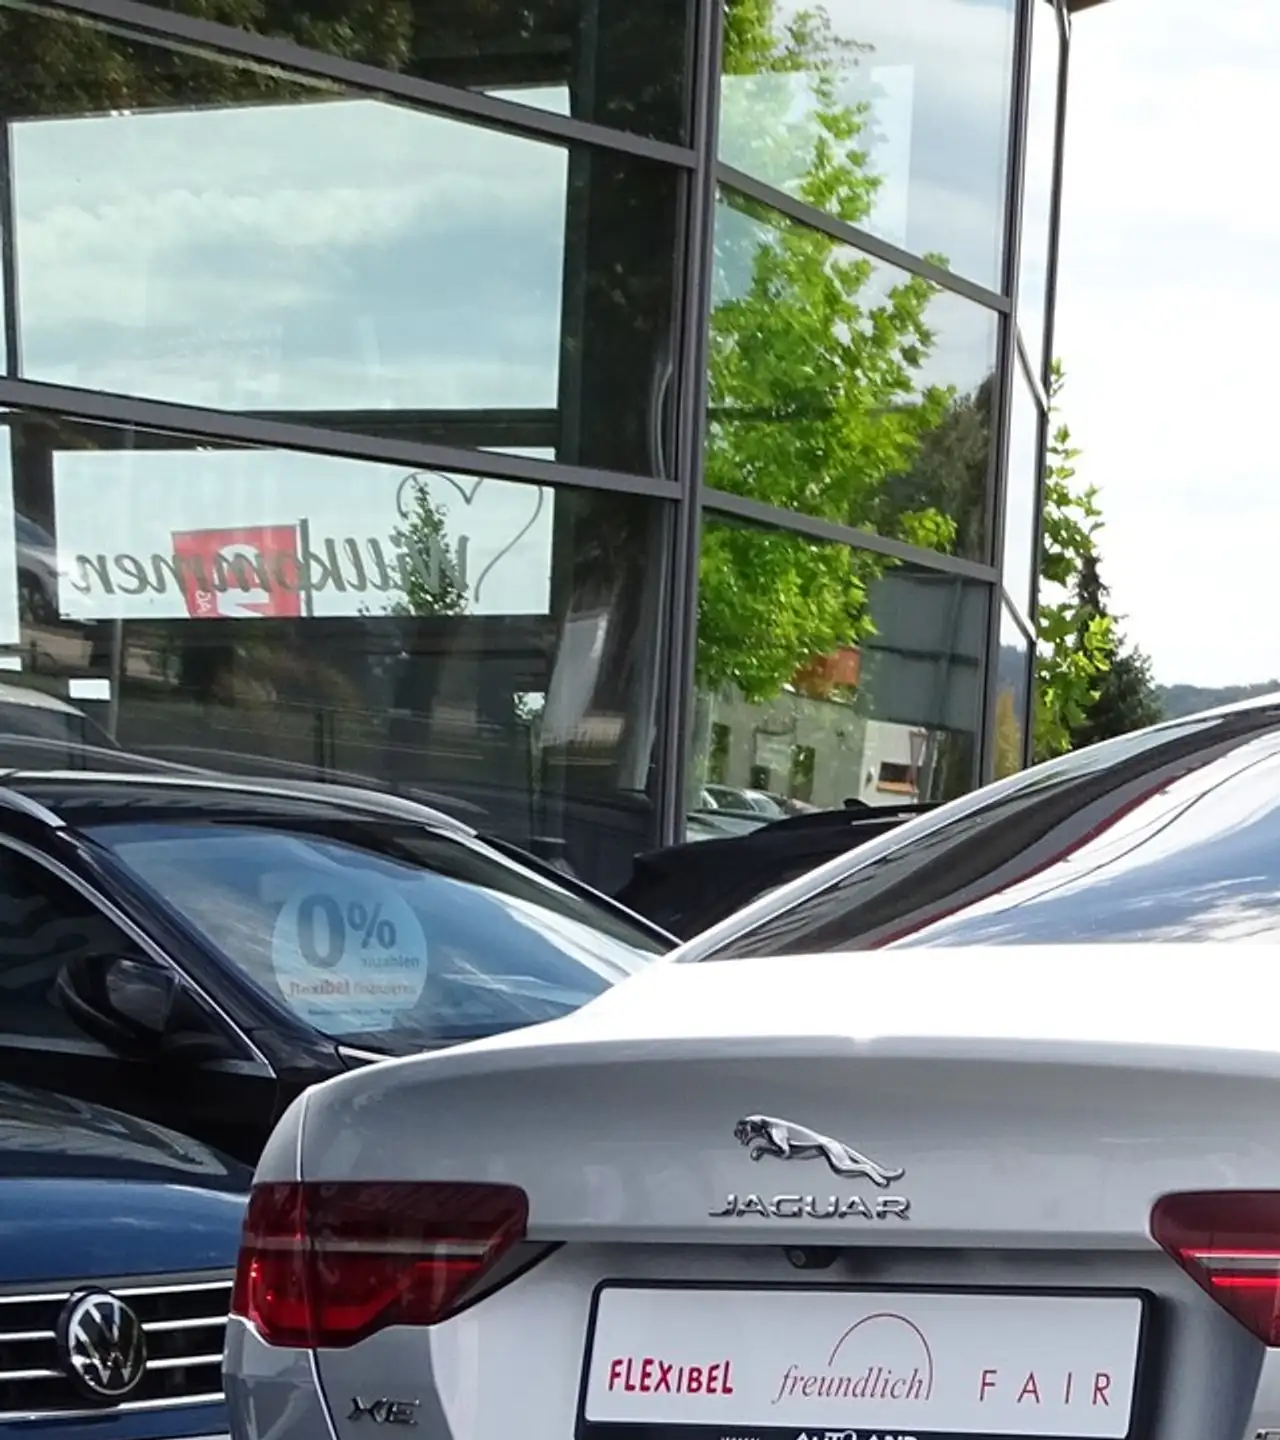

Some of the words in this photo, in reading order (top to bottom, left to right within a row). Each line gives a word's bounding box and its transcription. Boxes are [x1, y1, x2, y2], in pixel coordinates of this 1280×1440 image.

[297, 893, 397, 970] 0%
[708, 1194, 911, 1220] JAGUAR
[608, 1357, 733, 1395] FLEXIBEL
[771, 1364, 925, 1405] freundlich
[979, 1369, 1112, 1406] FAIR
[346, 1396, 421, 1425] XE
